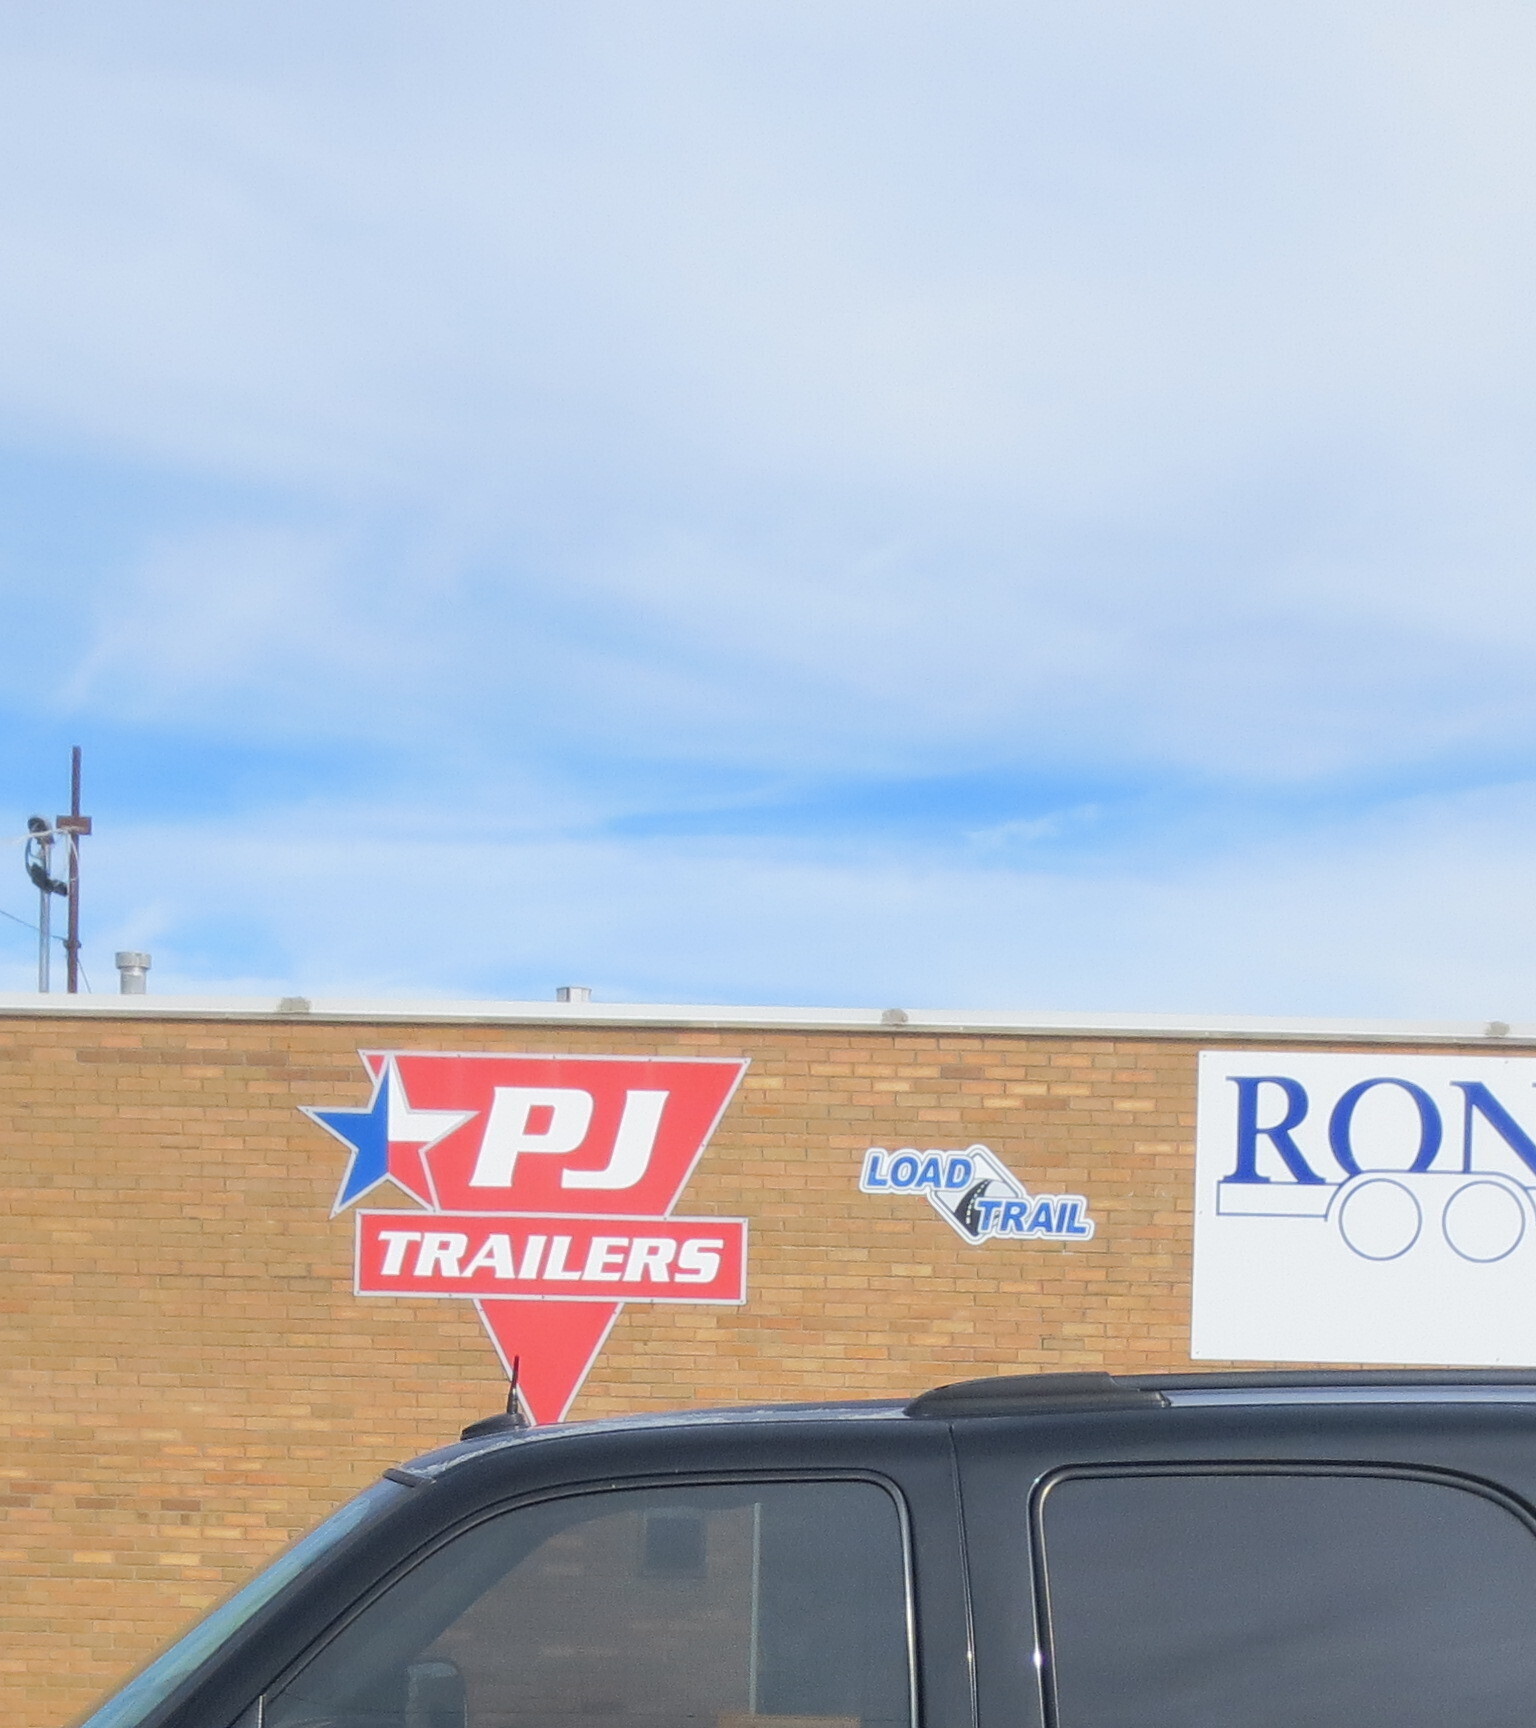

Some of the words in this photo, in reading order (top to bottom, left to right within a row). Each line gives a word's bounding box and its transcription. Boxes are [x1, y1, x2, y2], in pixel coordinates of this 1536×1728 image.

[468, 1087, 670, 1191] PJ
[866, 1152, 974, 1190] LOAD
[976, 1198, 1090, 1236] TRAIL
[377, 1231, 725, 1285] TRAILERS
